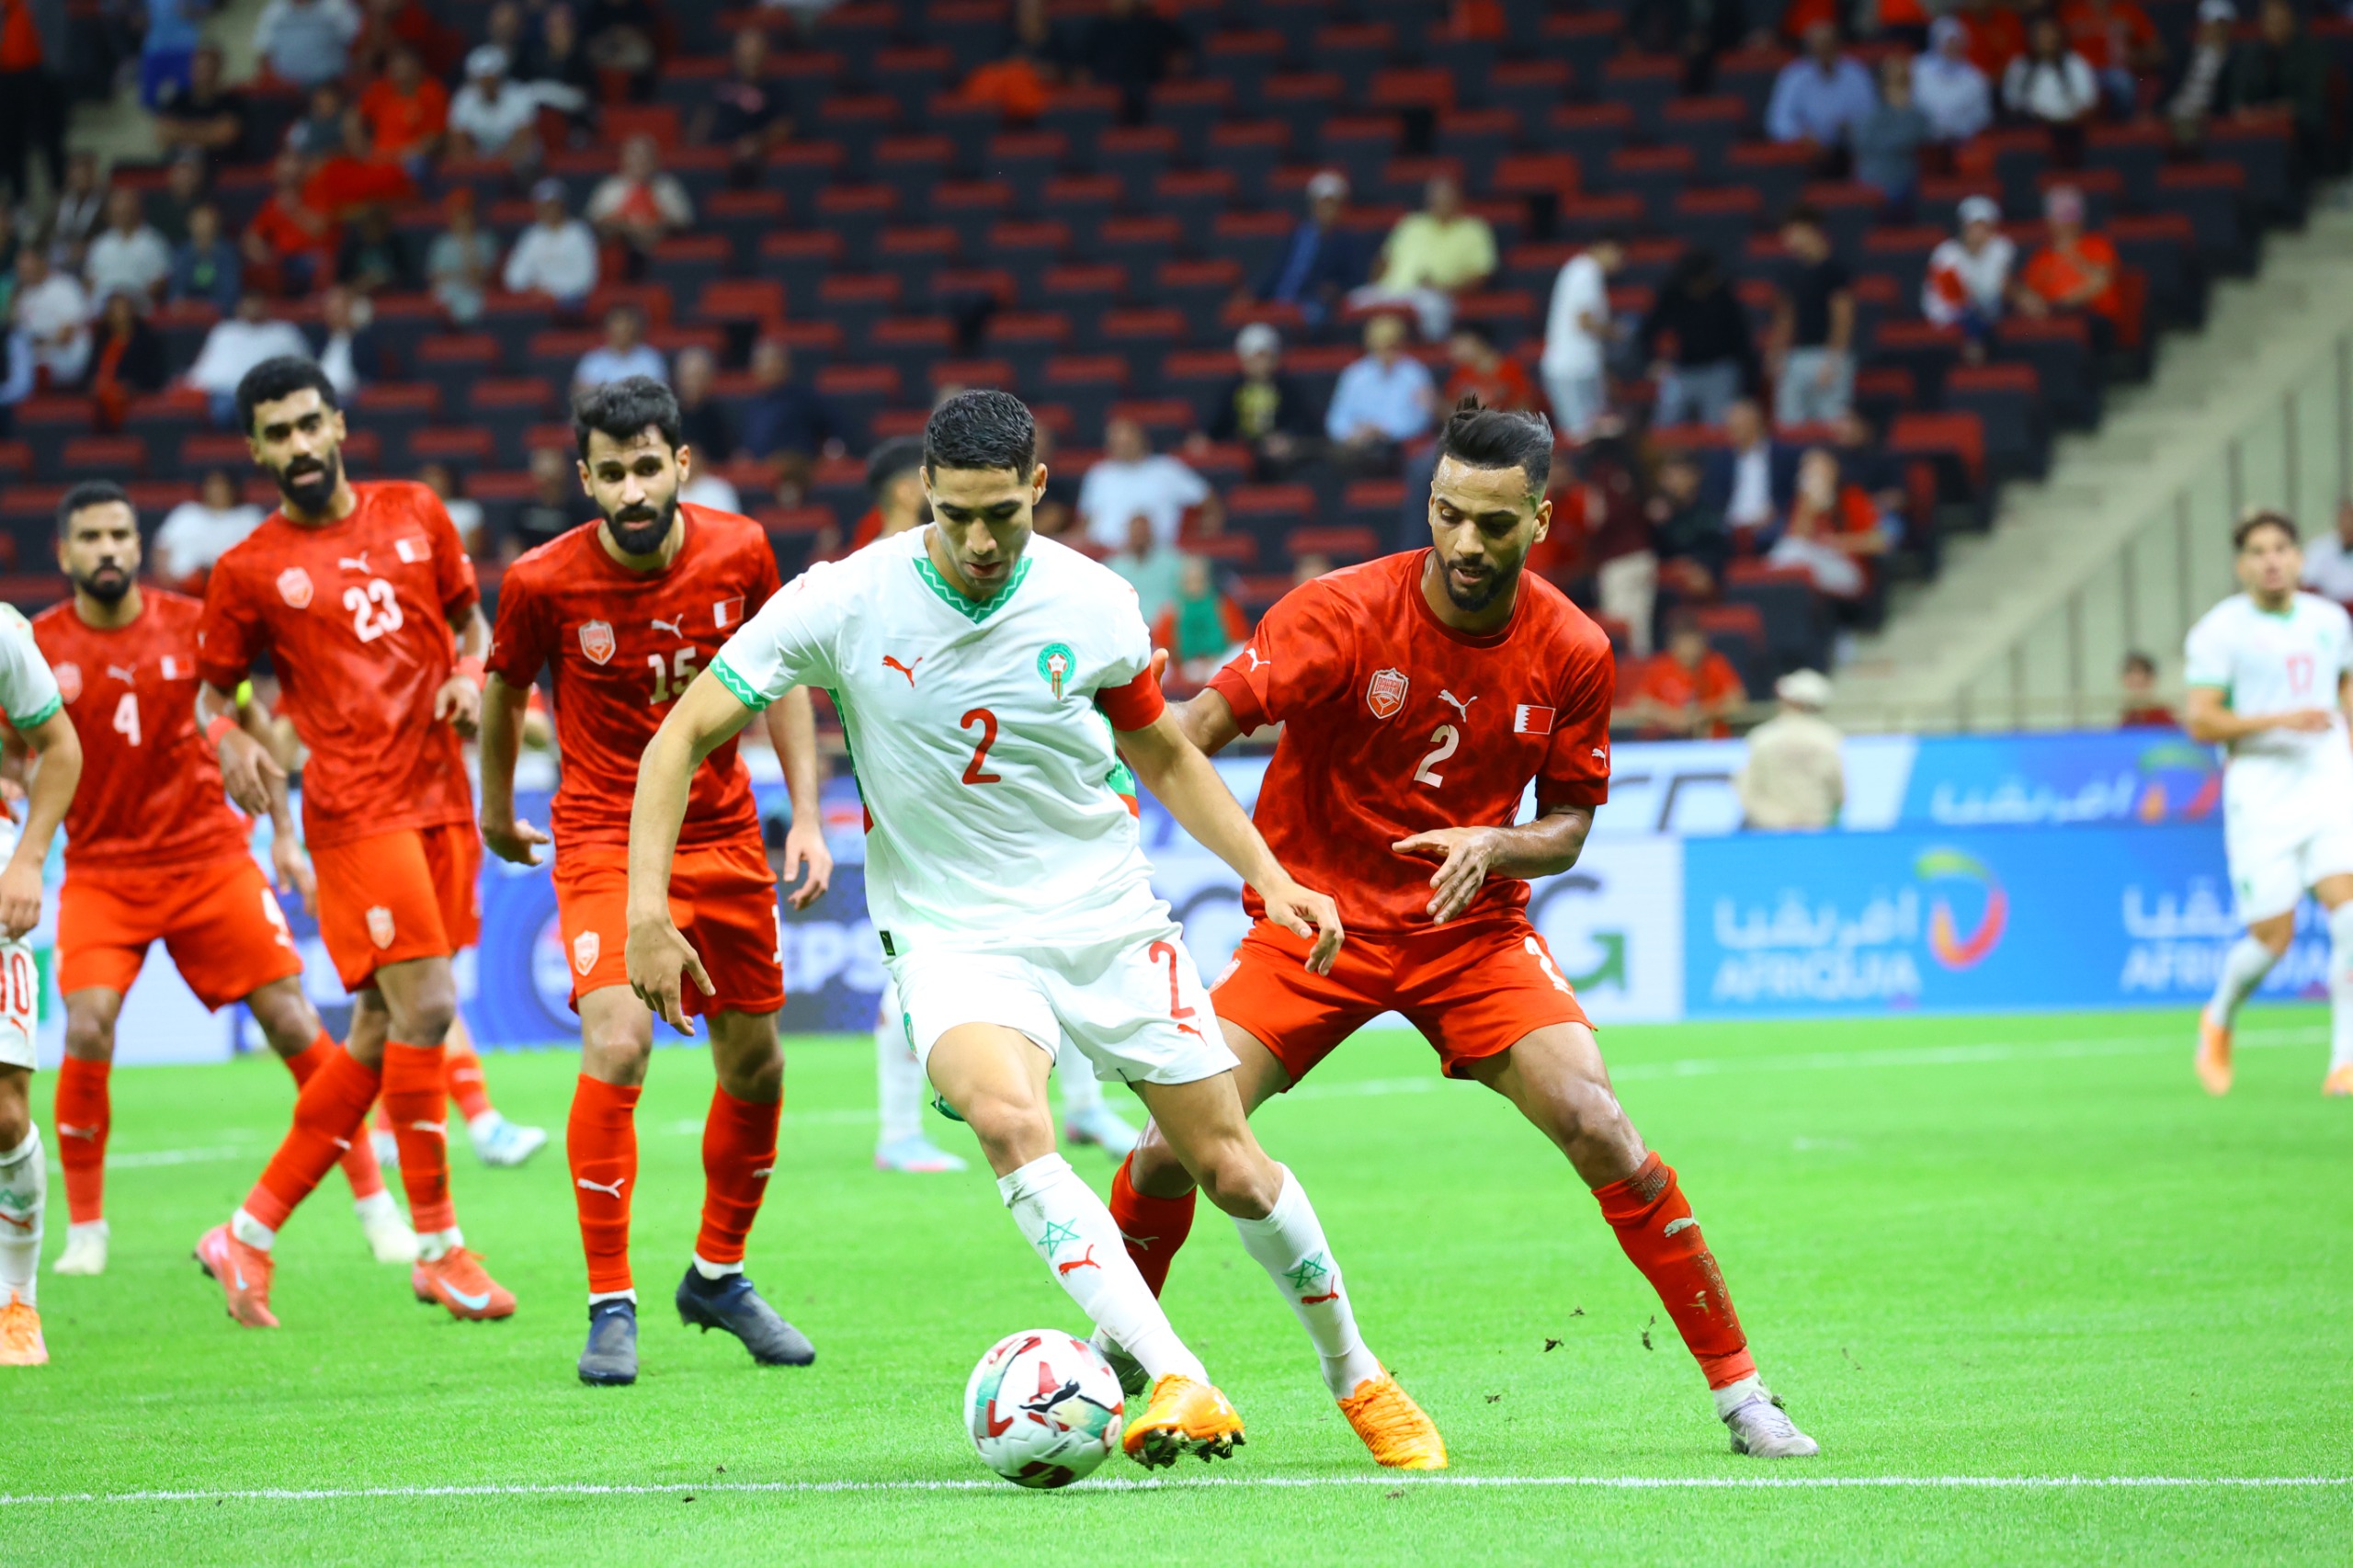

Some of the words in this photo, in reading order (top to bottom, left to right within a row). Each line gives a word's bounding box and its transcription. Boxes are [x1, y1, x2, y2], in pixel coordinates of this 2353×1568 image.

[343, 578, 404, 642] 23
[647, 646, 699, 705] 15
[112, 692, 142, 746] 4
[961, 708, 1001, 785] 2
[1414, 724, 1460, 789] 2
[1149, 940, 1196, 1020] 2
